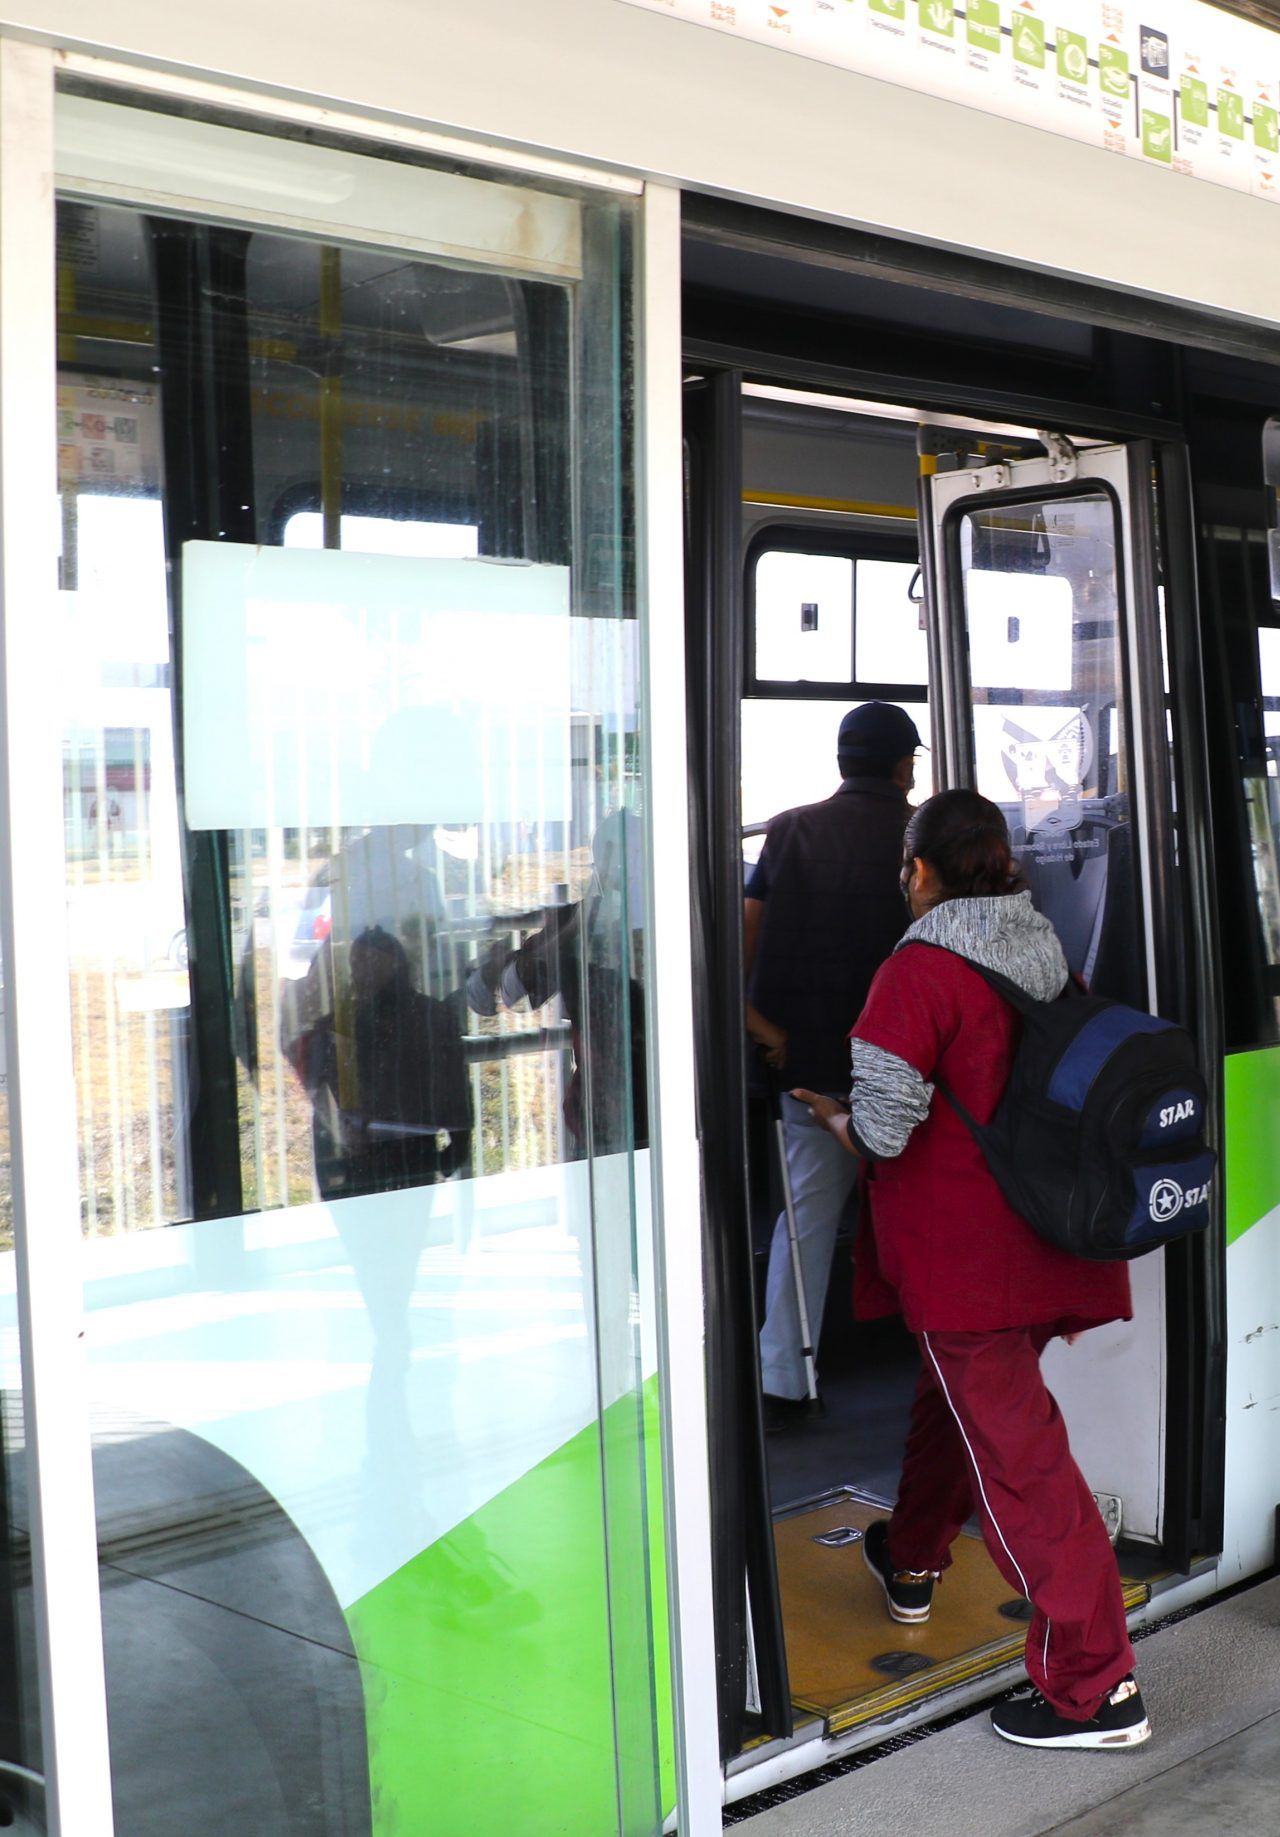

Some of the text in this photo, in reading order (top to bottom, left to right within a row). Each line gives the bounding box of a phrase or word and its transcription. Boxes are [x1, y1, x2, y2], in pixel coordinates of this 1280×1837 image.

[1012, 13, 1024, 26] 17
[1159, 1099, 1195, 1128] STAR
[1184, 1182, 1212, 1209] STA
